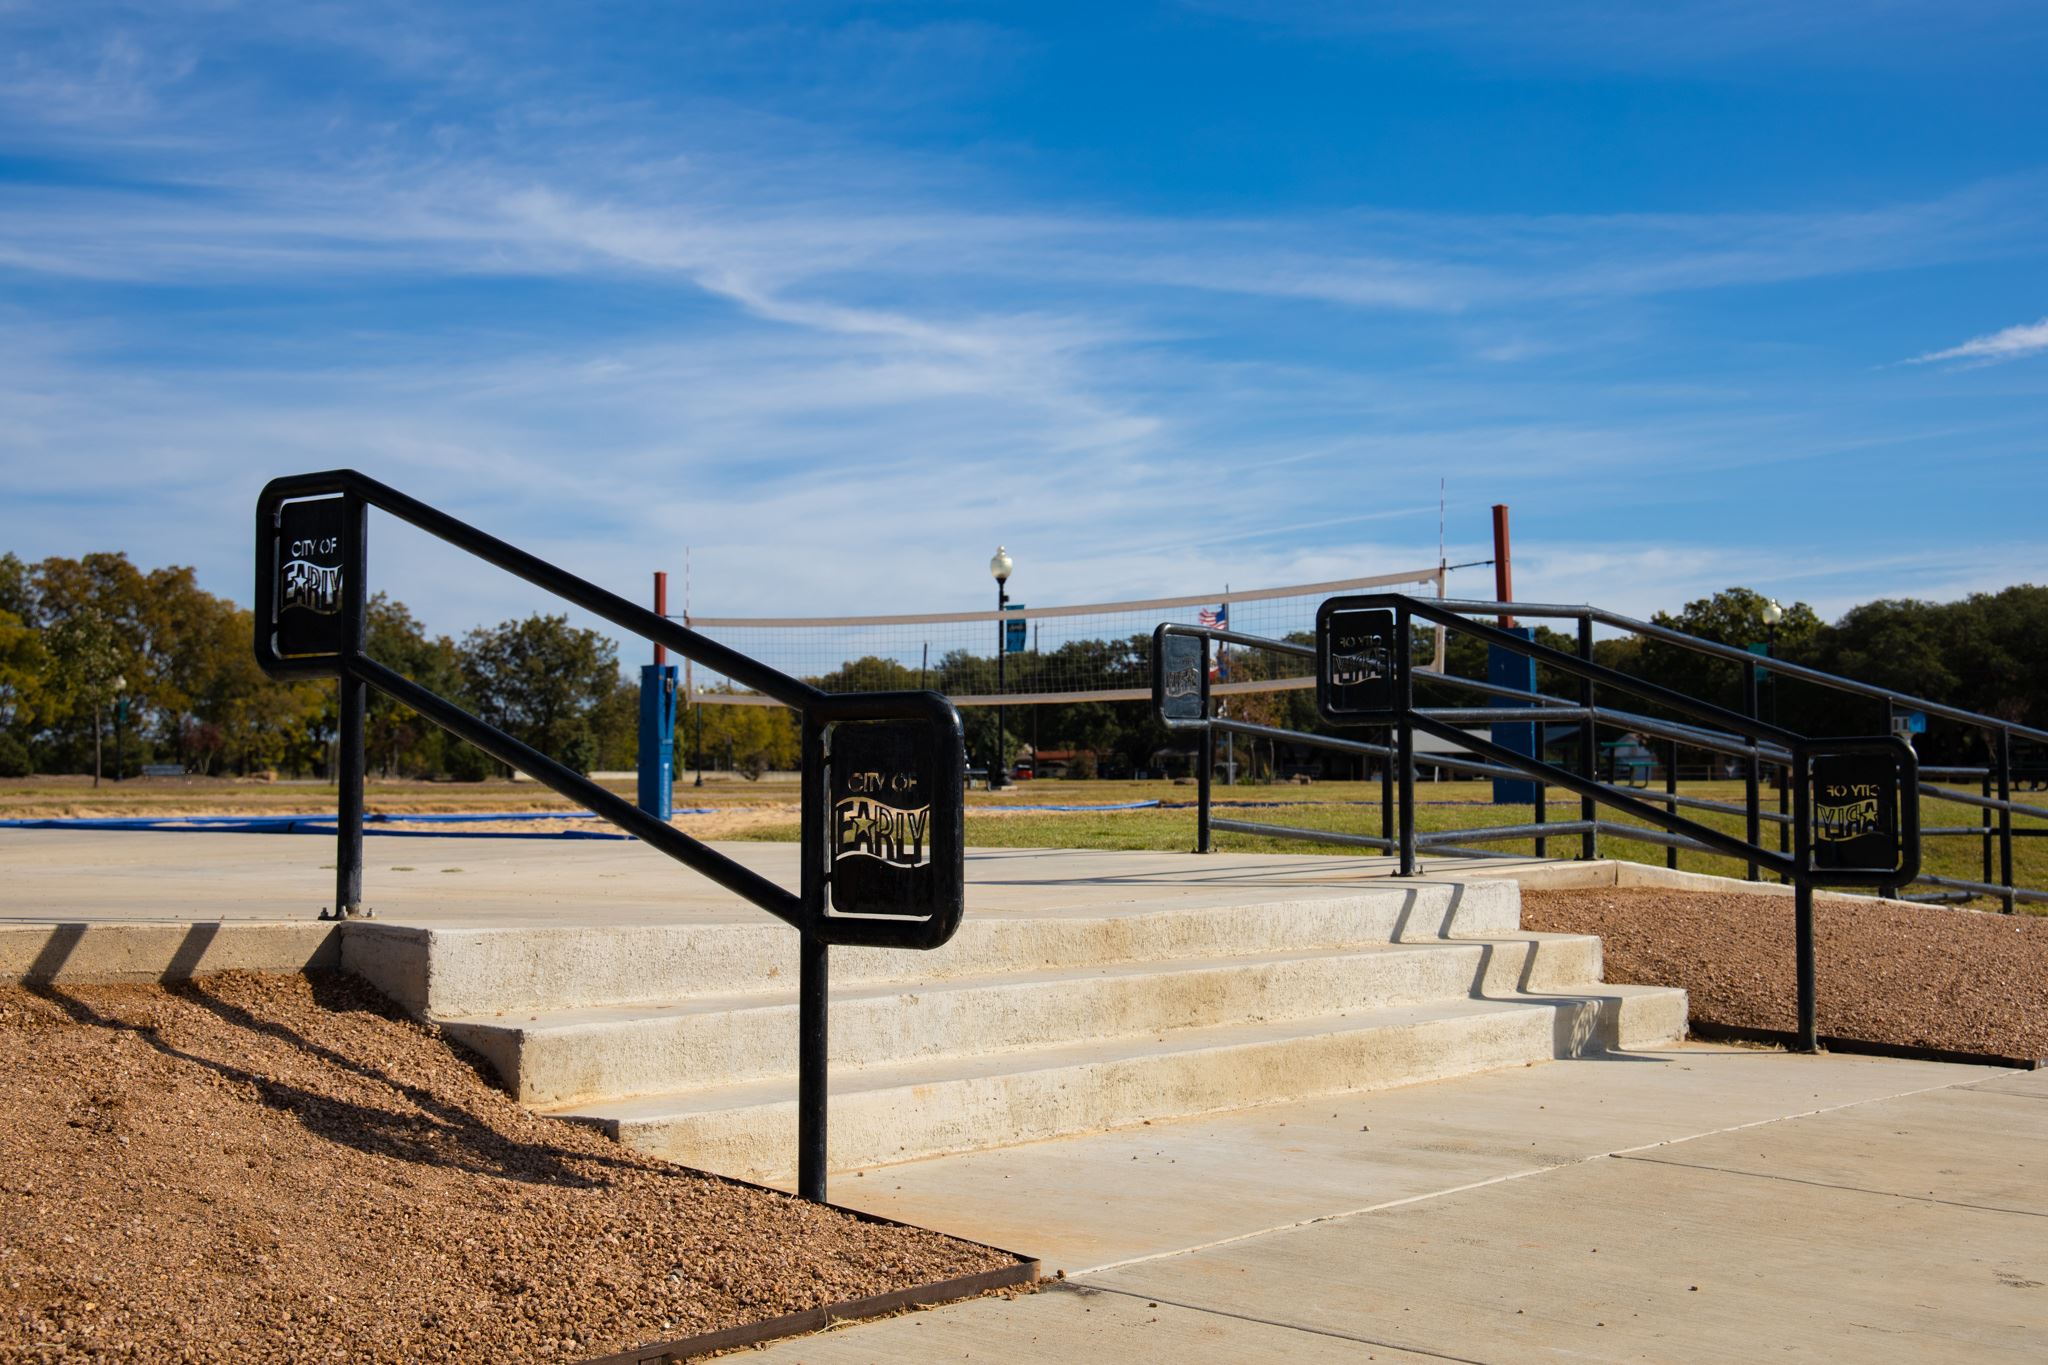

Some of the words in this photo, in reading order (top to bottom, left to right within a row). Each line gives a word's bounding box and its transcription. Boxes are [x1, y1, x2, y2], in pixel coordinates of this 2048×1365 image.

[291, 540, 316, 557] CITY
[320, 537, 337, 554] OF
[281, 561, 343, 614] EARLY
[848, 772, 885, 792] CITY
[892, 772, 918, 792] OF
[836, 797, 931, 867] EARLY
